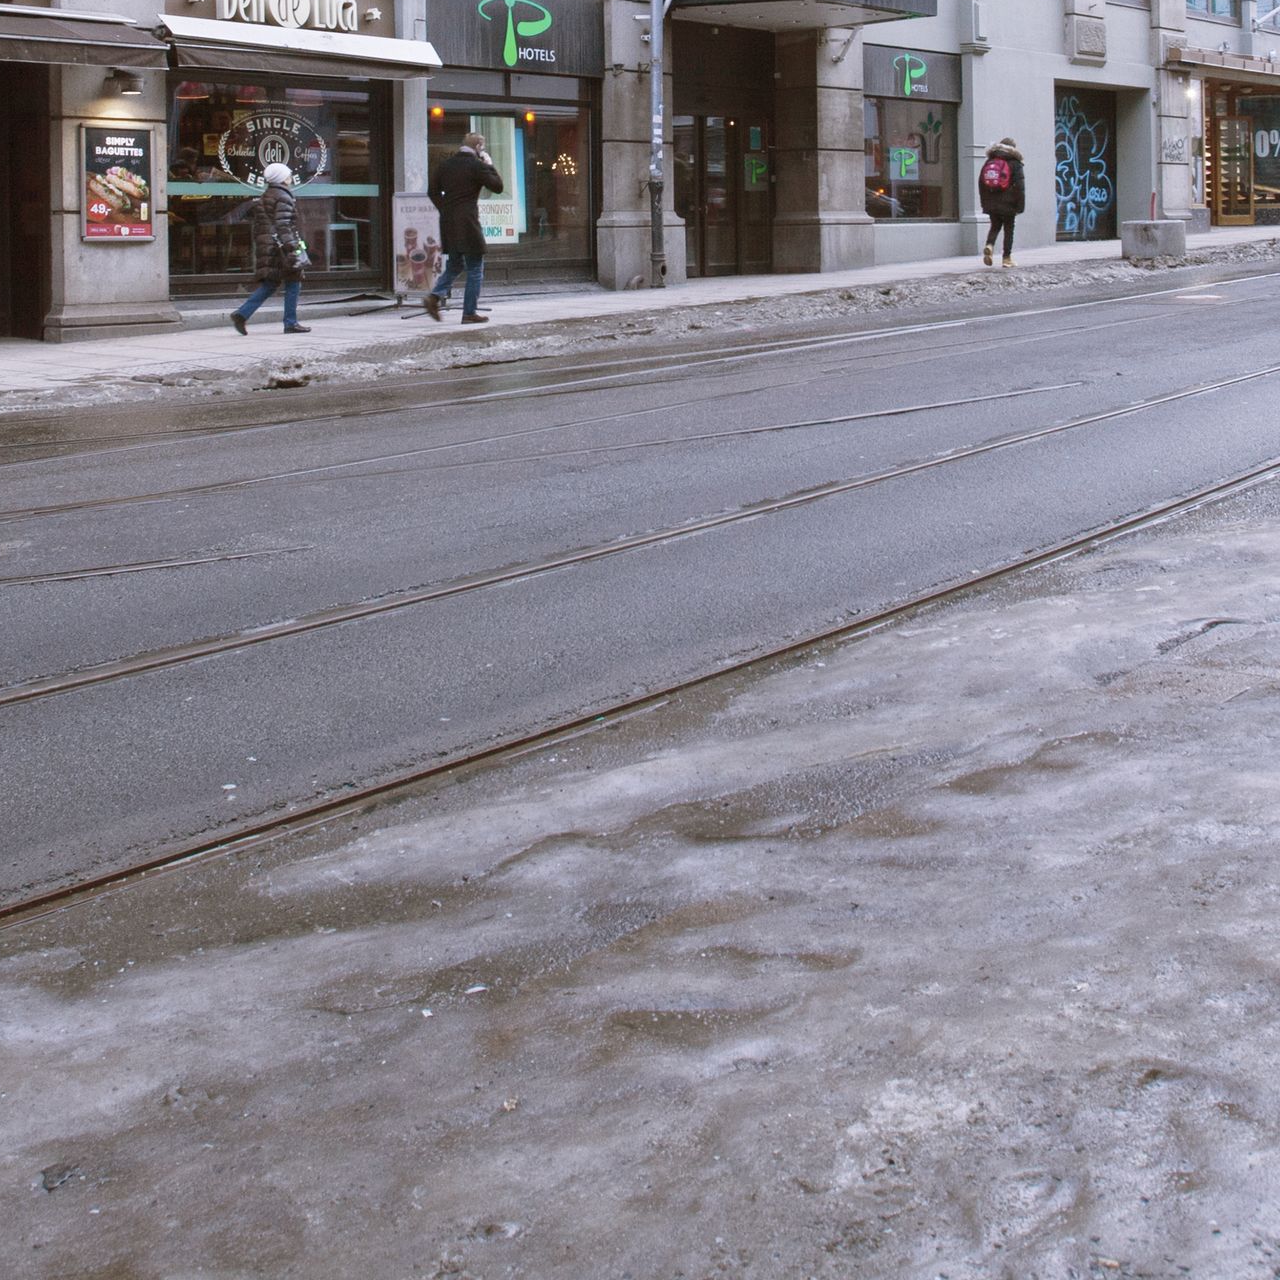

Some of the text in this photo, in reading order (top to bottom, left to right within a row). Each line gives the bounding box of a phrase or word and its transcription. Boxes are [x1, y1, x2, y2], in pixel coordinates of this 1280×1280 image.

[518, 47, 556, 62] HOTELS
[246, 117, 301, 135] SINGLE
[105, 136, 135, 146] SIMPLY
[95, 146, 144, 157] BAGUETTES
[265, 142, 282, 162] deli
[90, 203, 112, 216] 49,-
[400, 205, 417, 214] KEEP
